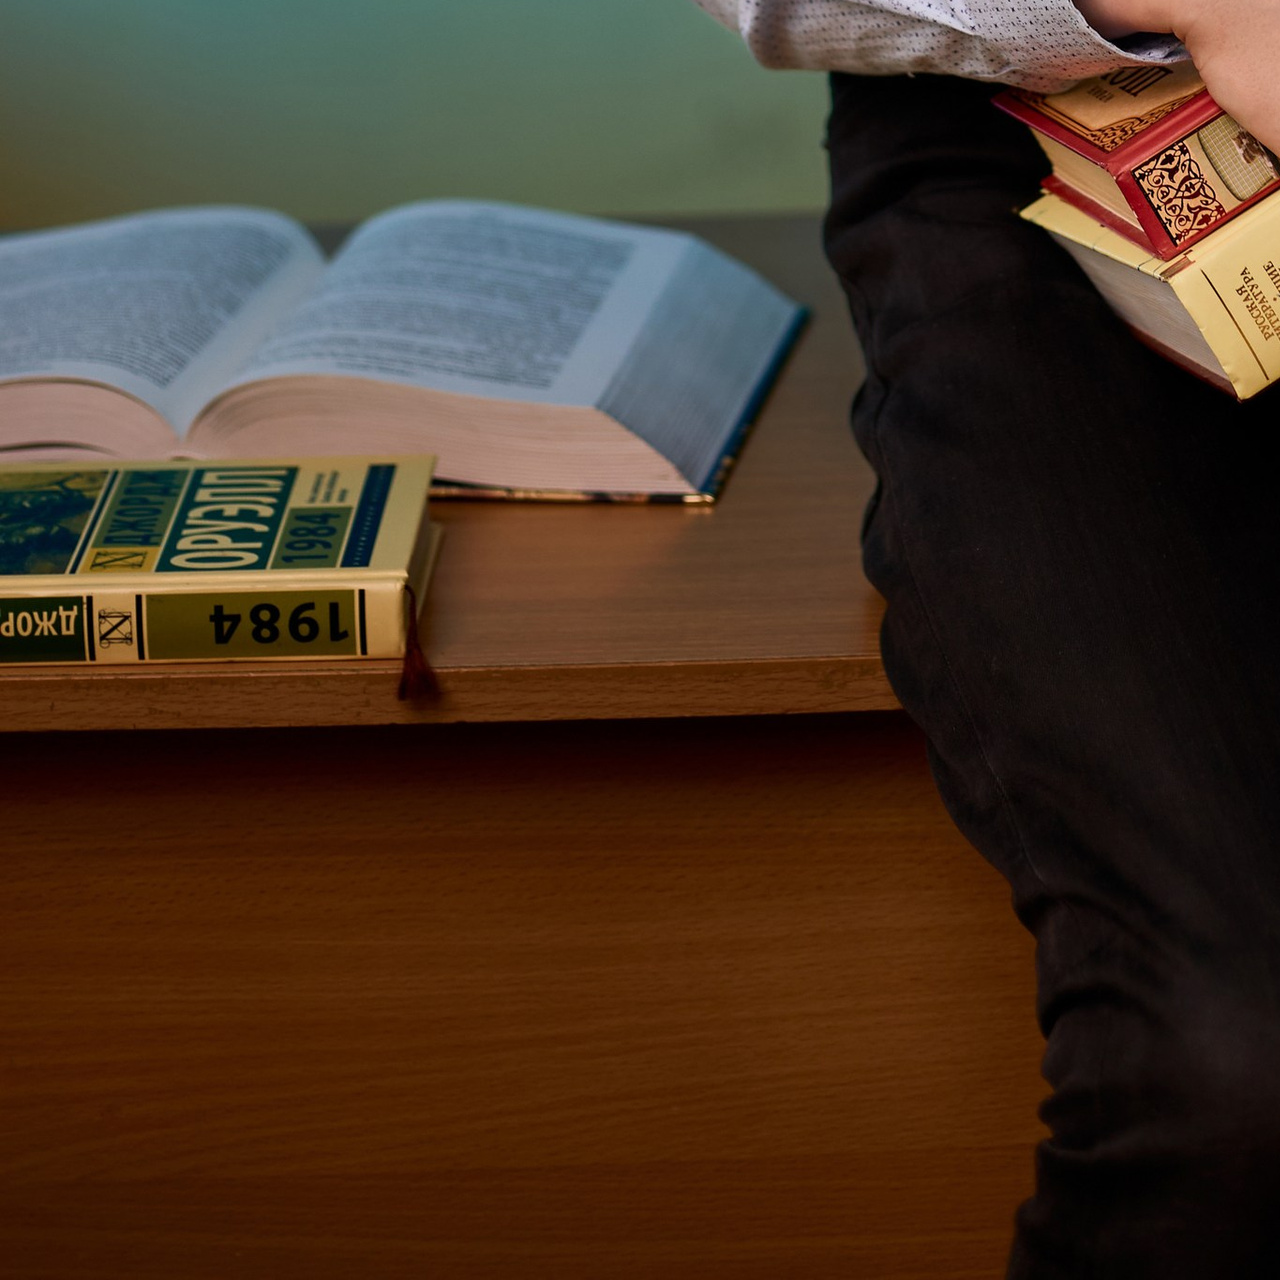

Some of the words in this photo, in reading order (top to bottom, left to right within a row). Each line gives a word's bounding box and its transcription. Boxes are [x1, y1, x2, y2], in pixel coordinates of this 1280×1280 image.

[1234, 284, 1275, 341] РУССКАЯ
[102, 469, 191, 546] ДЖОРДЖ
[169, 469, 289, 569] ОРУЭЛЛ
[281, 512, 342, 563] 1984
[209, 600, 349, 646] 1984
